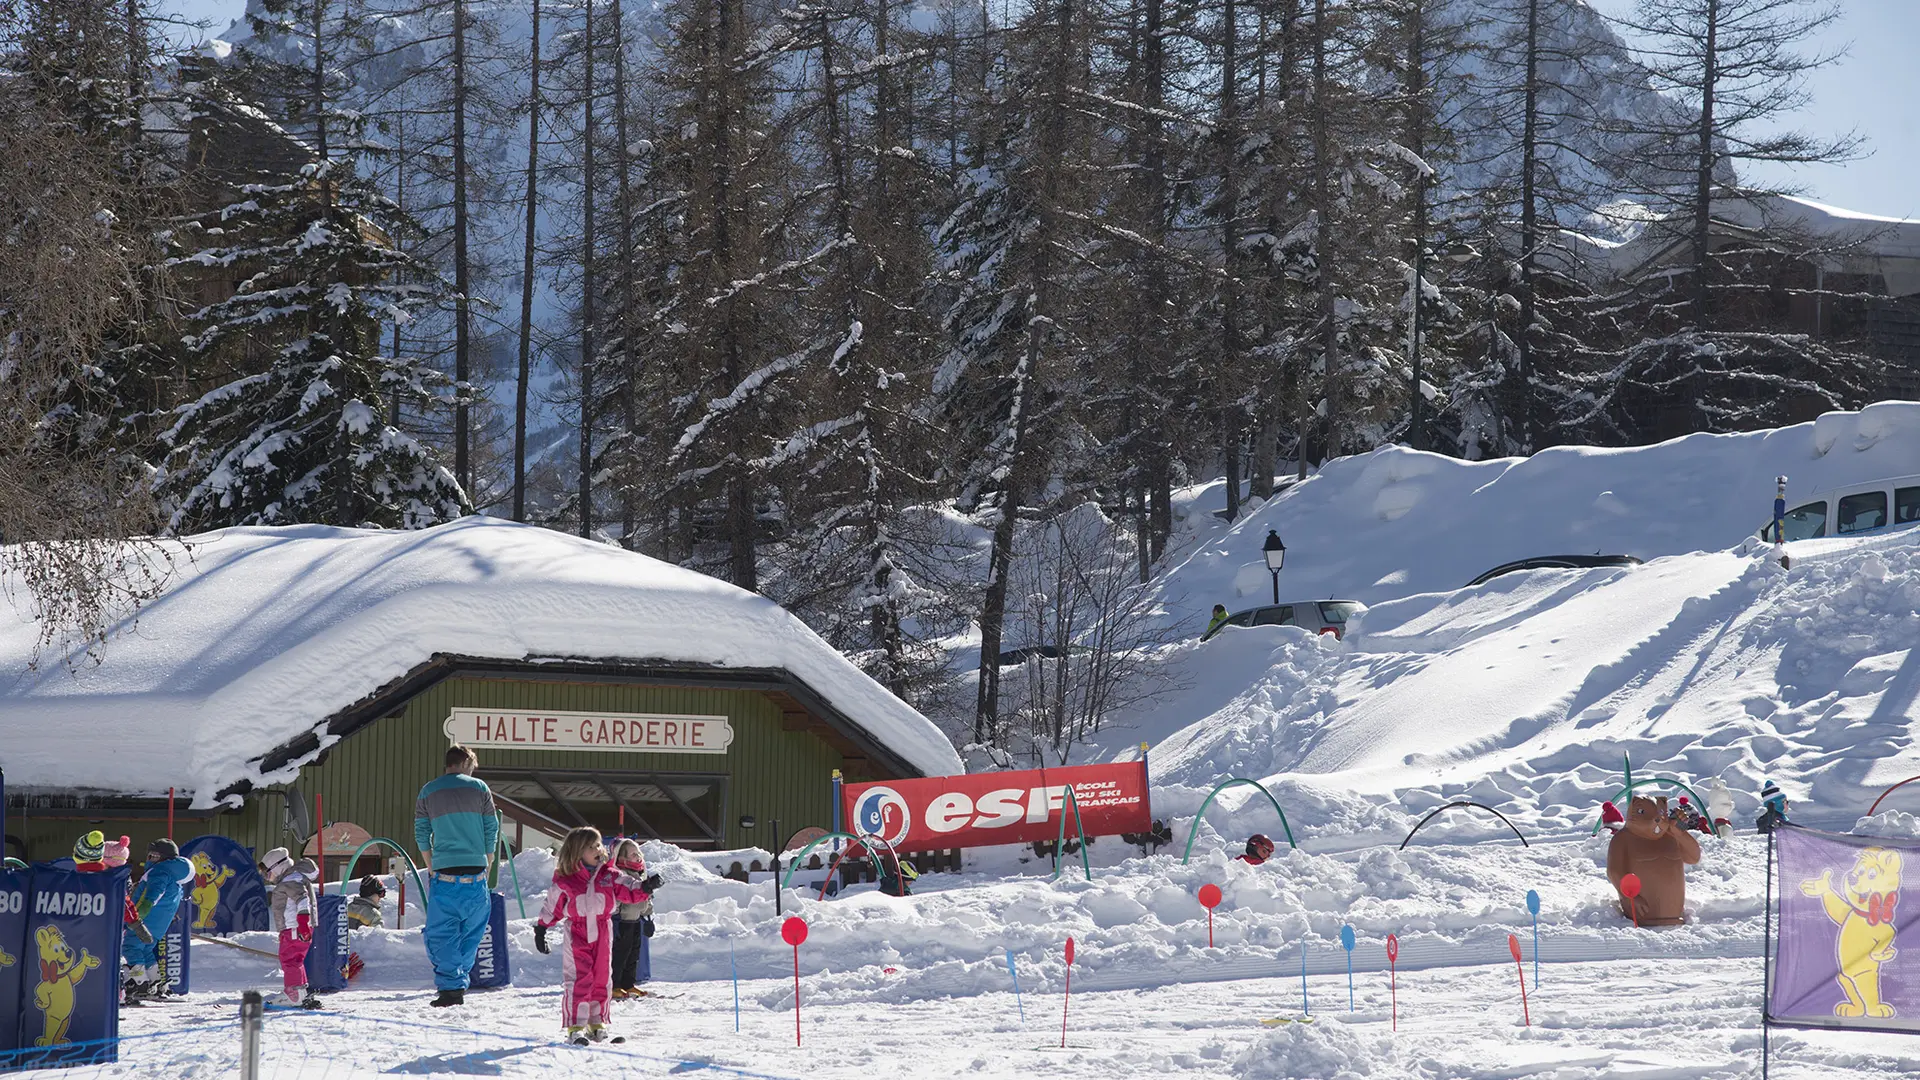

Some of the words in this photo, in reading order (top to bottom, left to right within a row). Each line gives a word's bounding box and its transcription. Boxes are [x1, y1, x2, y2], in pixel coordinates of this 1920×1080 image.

[1075, 791, 1096, 799] DU
[1099, 789, 1122, 797] SKI
[1076, 781, 1117, 791] ÉCOLE
[35, 890, 106, 916] HARIBO
[338, 903, 348, 955] HARIBO
[167, 933, 182, 986] HARIBO
